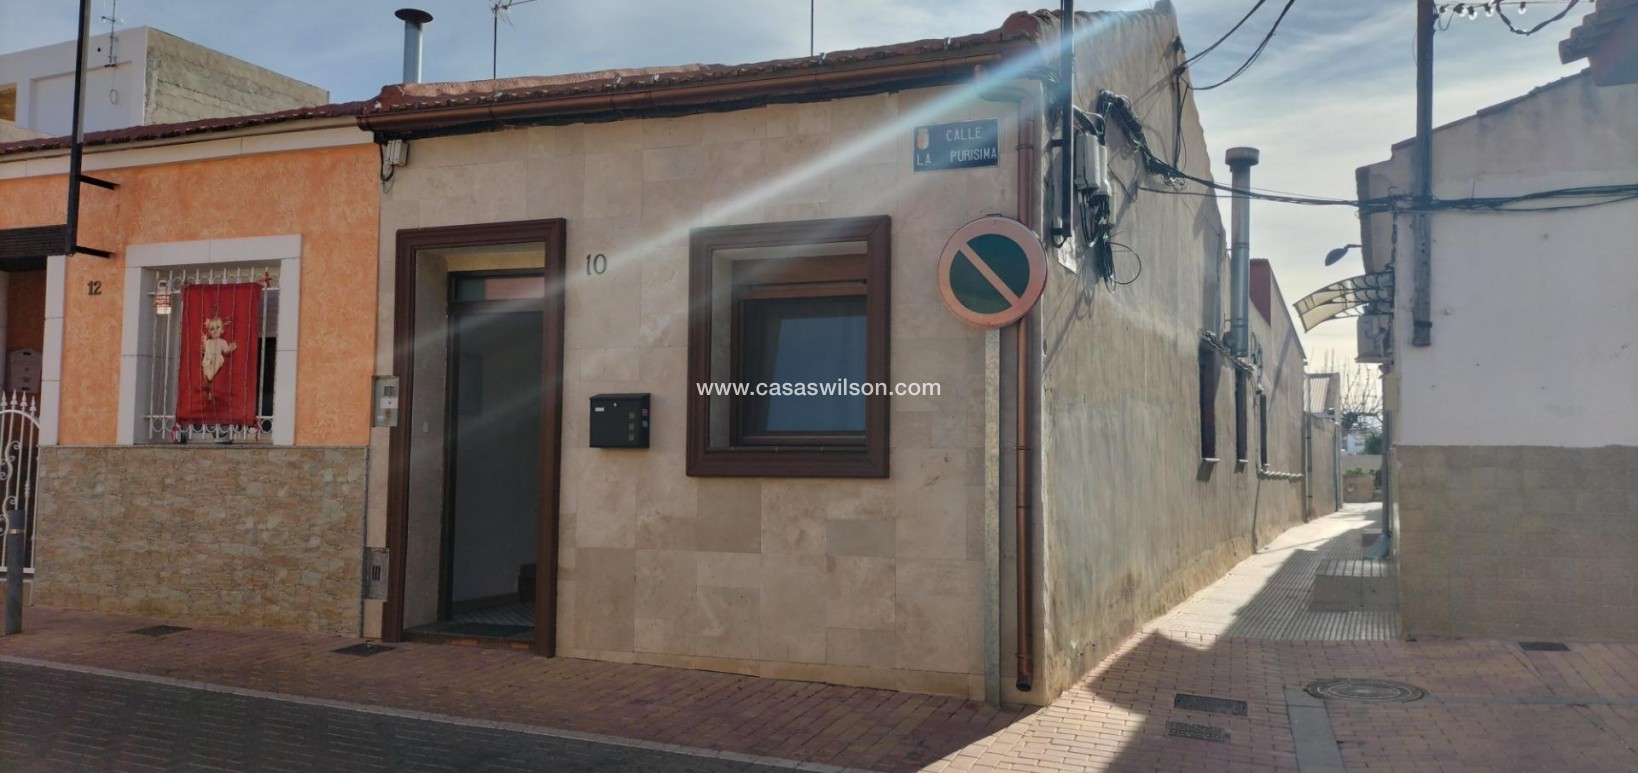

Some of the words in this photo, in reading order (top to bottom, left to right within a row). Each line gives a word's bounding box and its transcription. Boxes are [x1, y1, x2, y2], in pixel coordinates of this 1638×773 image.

[945, 127, 983, 142] CALLE
[916, 153, 932, 166] LA
[950, 147, 997, 163] PURISIMA
[586, 253, 607, 276] 10
[87, 280, 102, 296] 12
